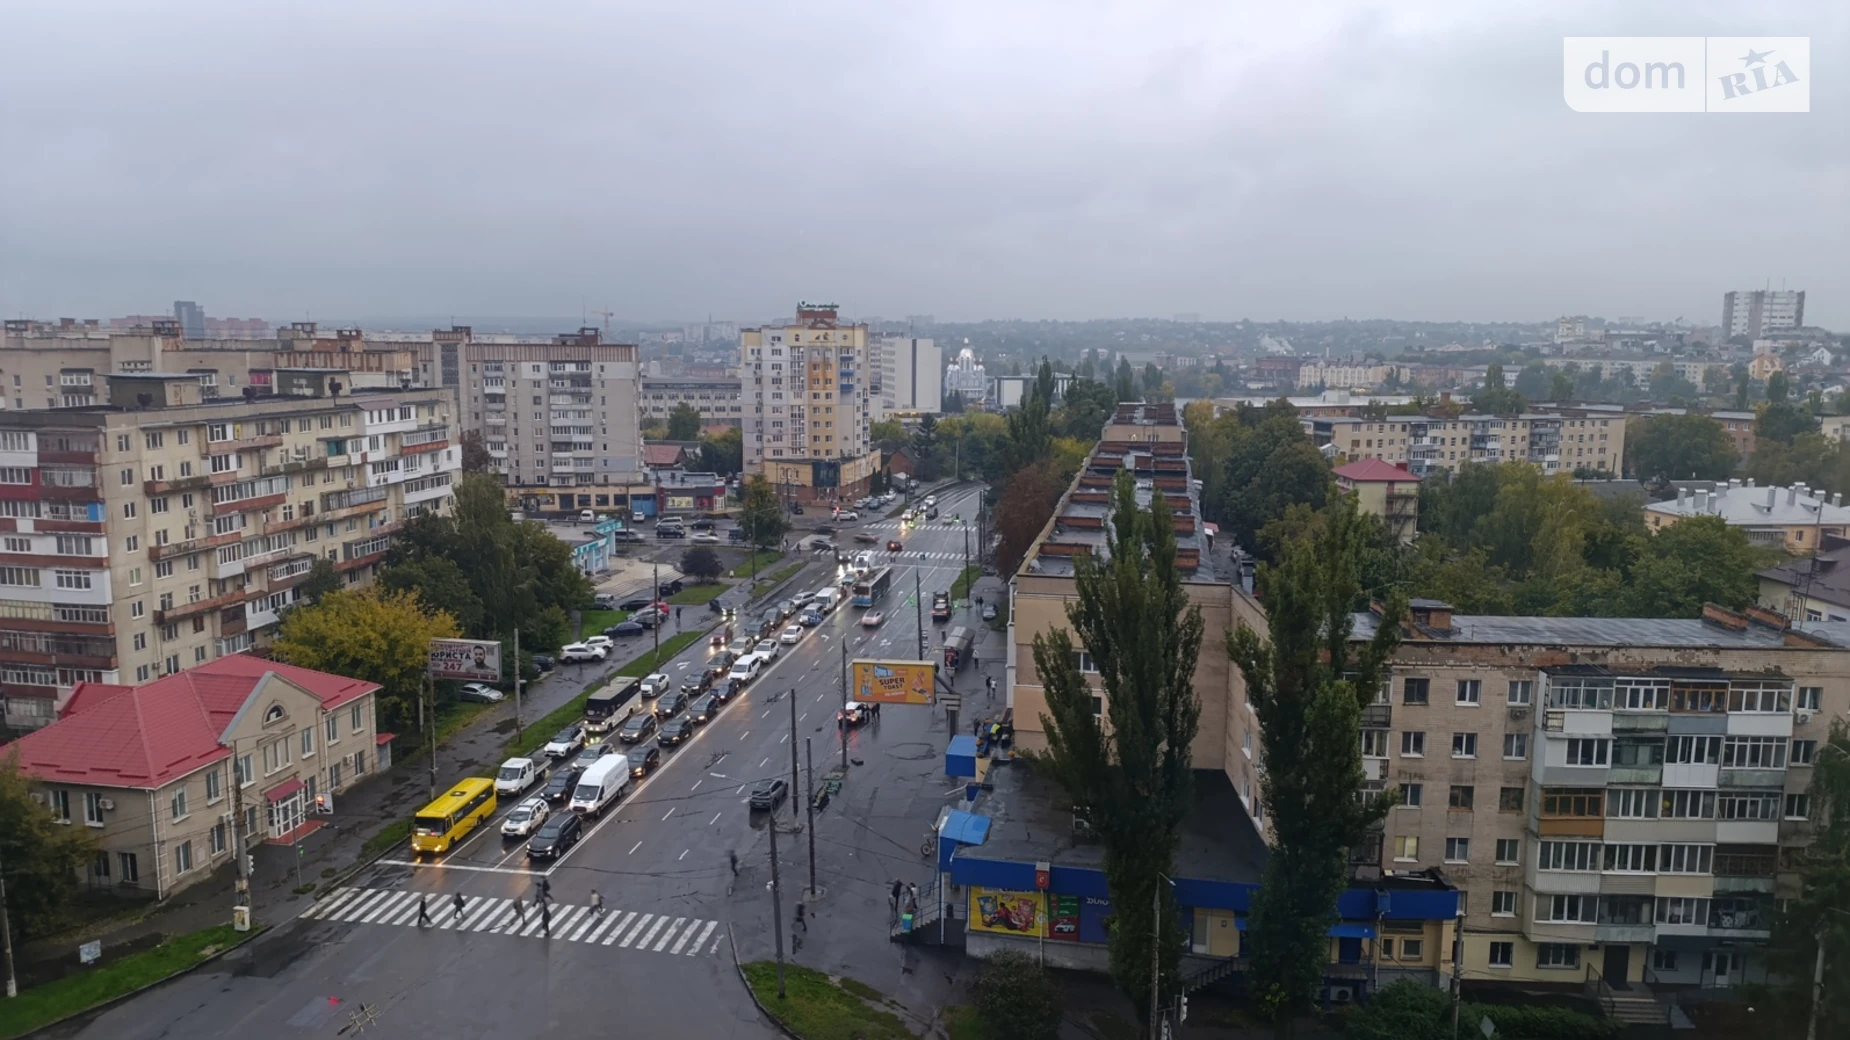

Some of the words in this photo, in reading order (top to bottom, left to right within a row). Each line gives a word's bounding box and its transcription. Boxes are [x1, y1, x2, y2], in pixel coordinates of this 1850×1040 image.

[431, 651, 471, 660] ЮРИСТА
[443, 662, 462, 671] 247
[879, 677, 905, 686] SUPER
